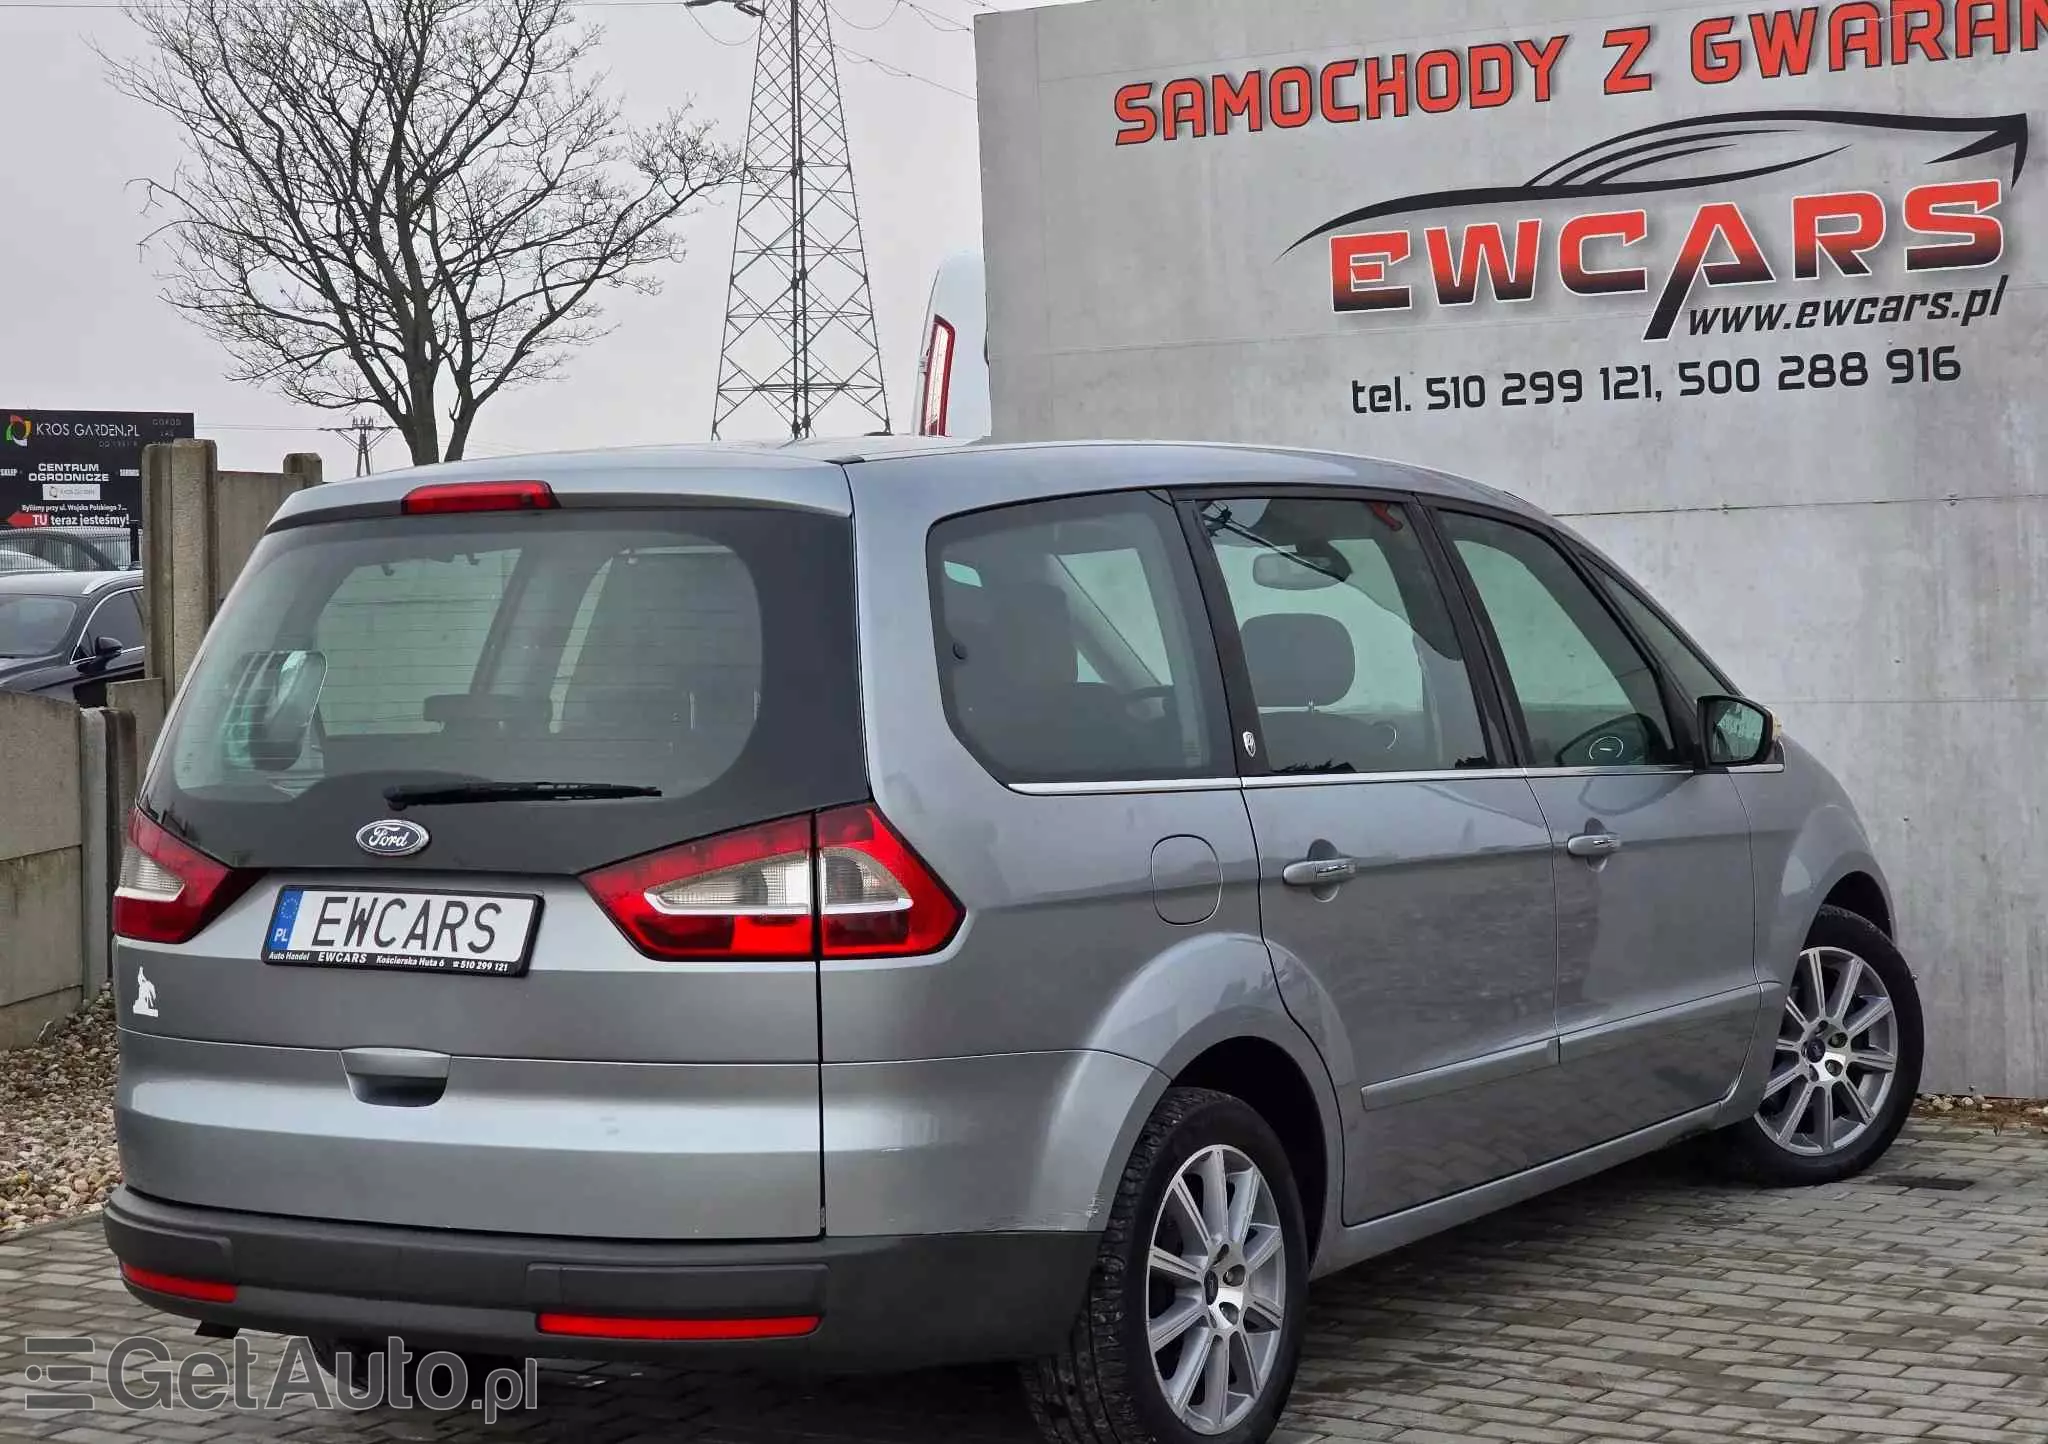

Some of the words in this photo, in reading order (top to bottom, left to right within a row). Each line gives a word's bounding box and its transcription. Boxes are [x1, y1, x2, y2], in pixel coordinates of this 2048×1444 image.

[1114, 34, 1569, 146] SAMOCHODY
[1602, 25, 1652, 96] Z
[1329, 178, 2004, 341] EWCARS
[1688, 274, 2009, 336] www.ewcars.pl
[1351, 377, 1411, 414] tel.
[1426, 374, 1487, 411] 510
[1501, 369, 1584, 406] 299
[1599, 363, 1663, 403] 121,
[1679, 358, 1761, 397] 500
[1778, 351, 1868, 391] 288
[1886, 345, 1962, 385] 916
[36, 423, 70, 436] KROS
[74, 424, 140, 437] GARDEN.PL
[28, 473, 110, 482] OGRODNICZE
[38, 463, 99, 472] CENTRUM
[32, 514, 48, 525] TU
[50, 515, 78, 525] teraz
[80, 513, 130, 527] jesteśmy!
[368, 825, 407, 848] Ford
[274, 928, 289, 942] PL
[311, 896, 502, 954] EWCARS
[268, 951, 285, 960] Auto
[286, 951, 310, 961] Handel
[317, 952, 367, 964] EWCARS
[419, 957, 437, 967] Huta
[460, 960, 475, 969] 510
[476, 961, 493, 970] 299
[494, 962, 508, 972] 121
